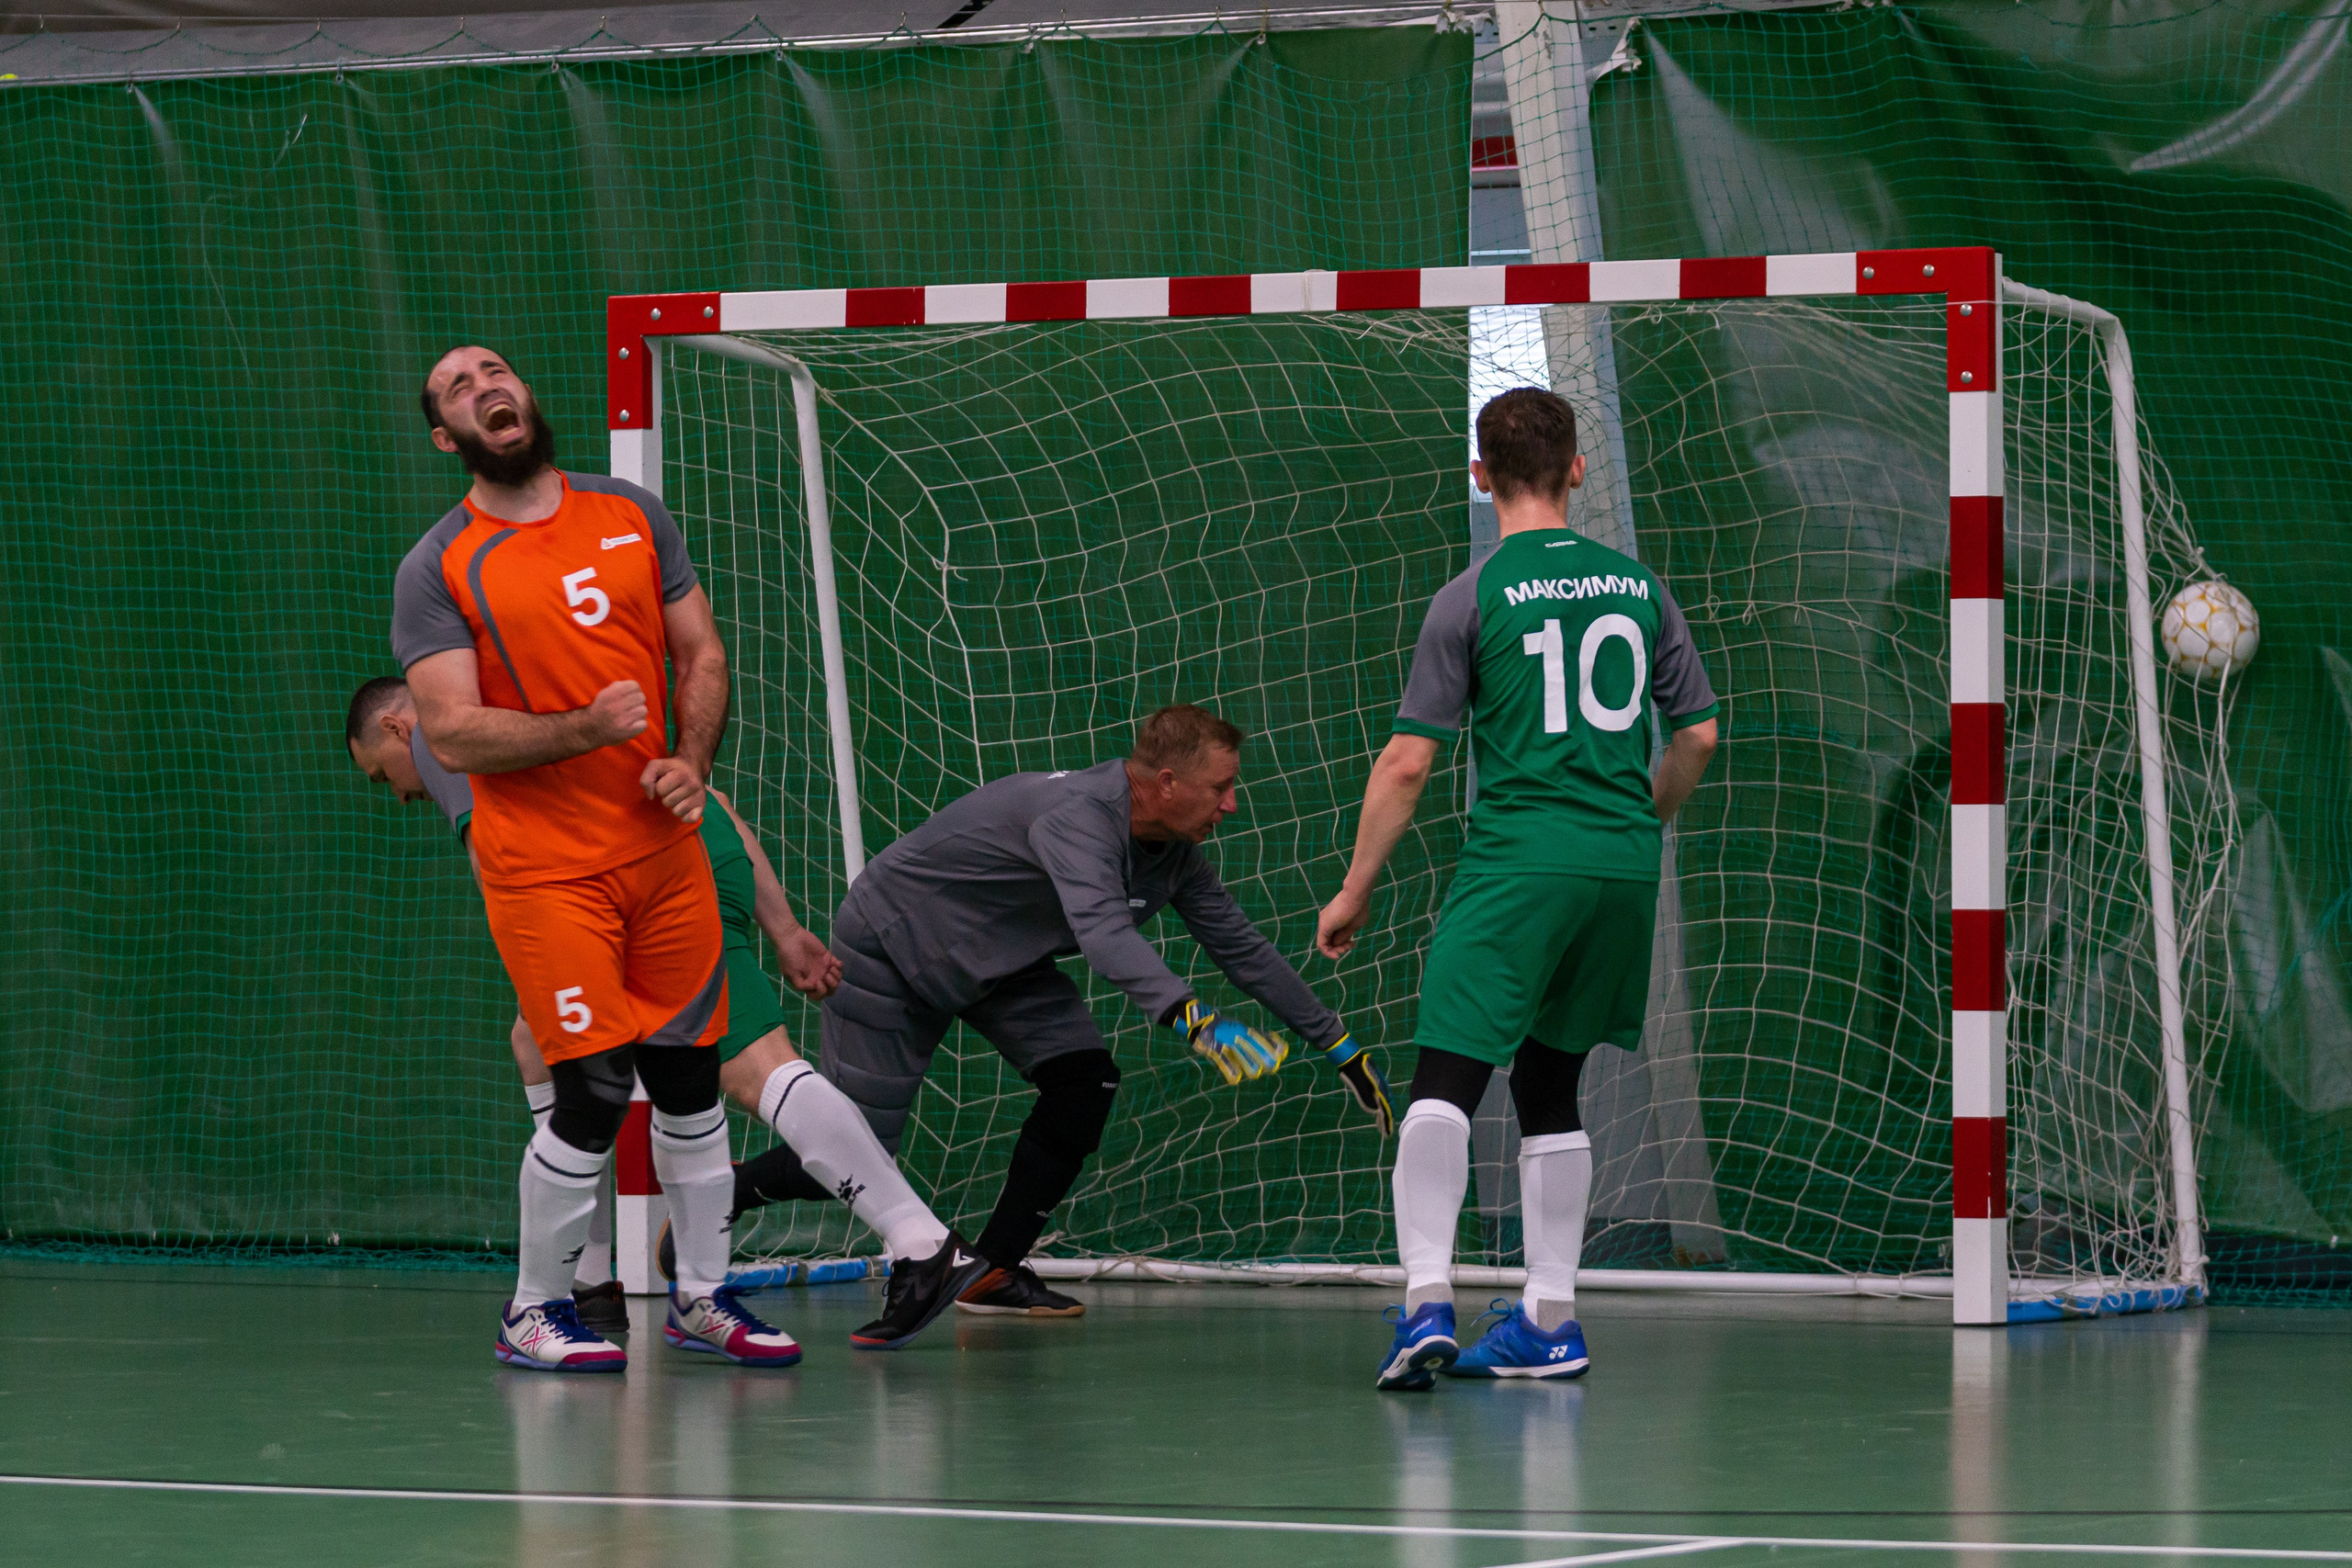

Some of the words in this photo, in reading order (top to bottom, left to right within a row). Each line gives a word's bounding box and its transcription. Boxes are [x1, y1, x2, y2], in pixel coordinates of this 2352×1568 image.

[561, 567, 611, 626] 5
[1503, 574, 1649, 607] МАКСИМУМ
[1522, 613, 1647, 734] 10
[554, 986, 594, 1033] 5
